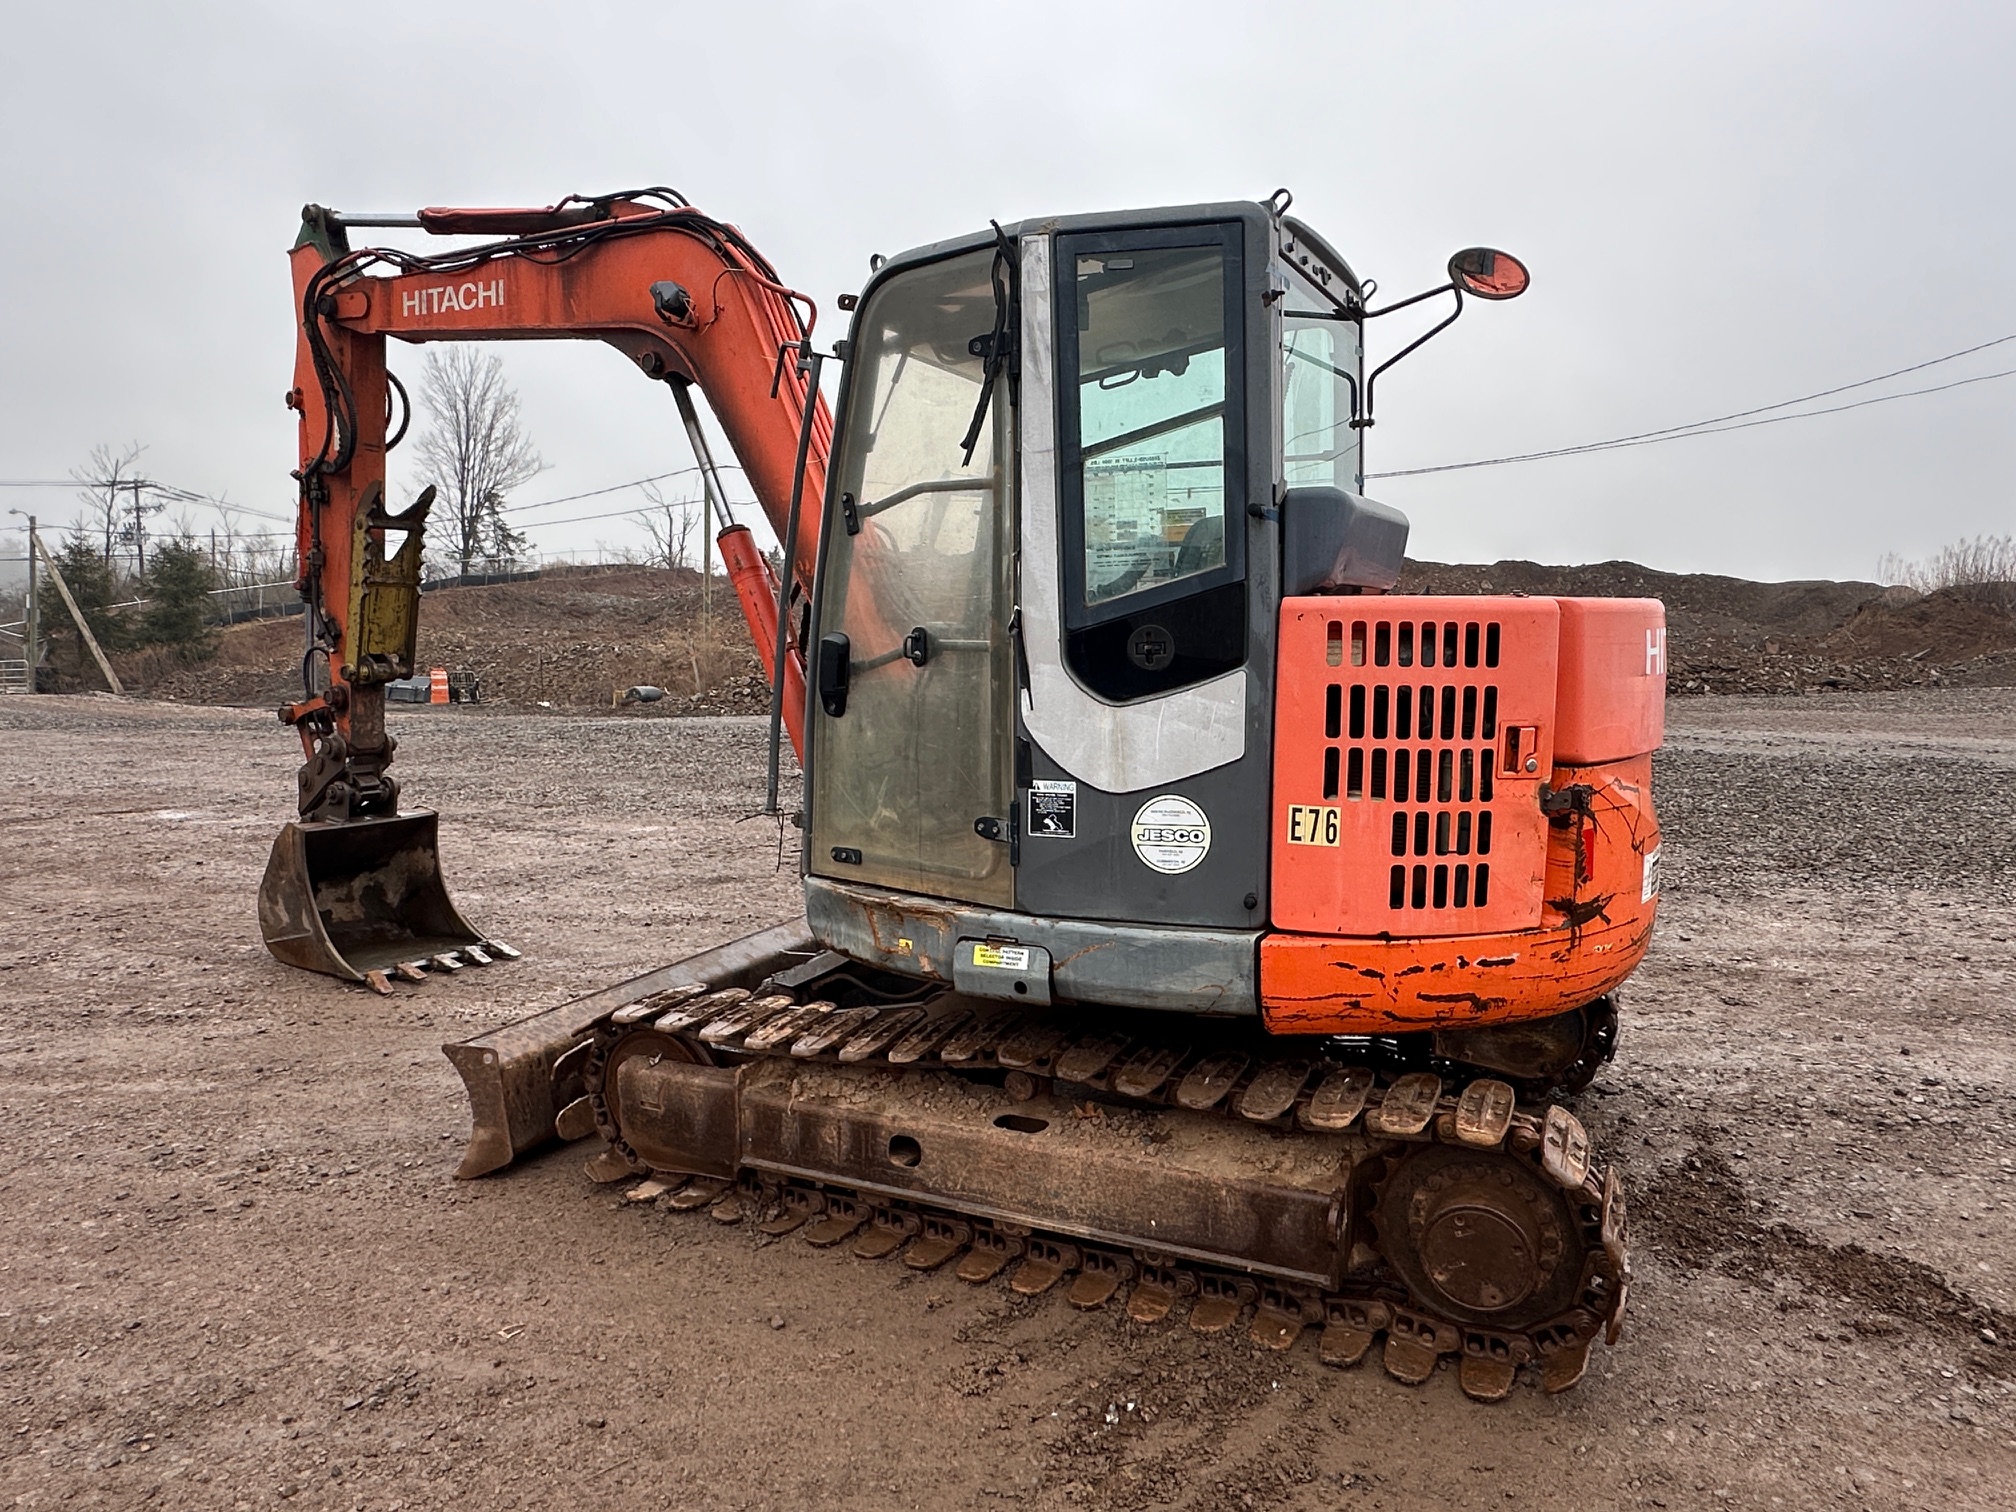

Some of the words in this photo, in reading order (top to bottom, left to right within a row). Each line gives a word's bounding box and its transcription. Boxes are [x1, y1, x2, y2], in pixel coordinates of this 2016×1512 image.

[402, 279, 504, 317] HITACHI
[1646, 627, 1667, 675] HI
[1043, 783, 1075, 792] WARNING
[1137, 828, 1205, 843] JESCO
[1291, 807, 1338, 844] E76
[982, 959, 1019, 967] COMPARTMENT
